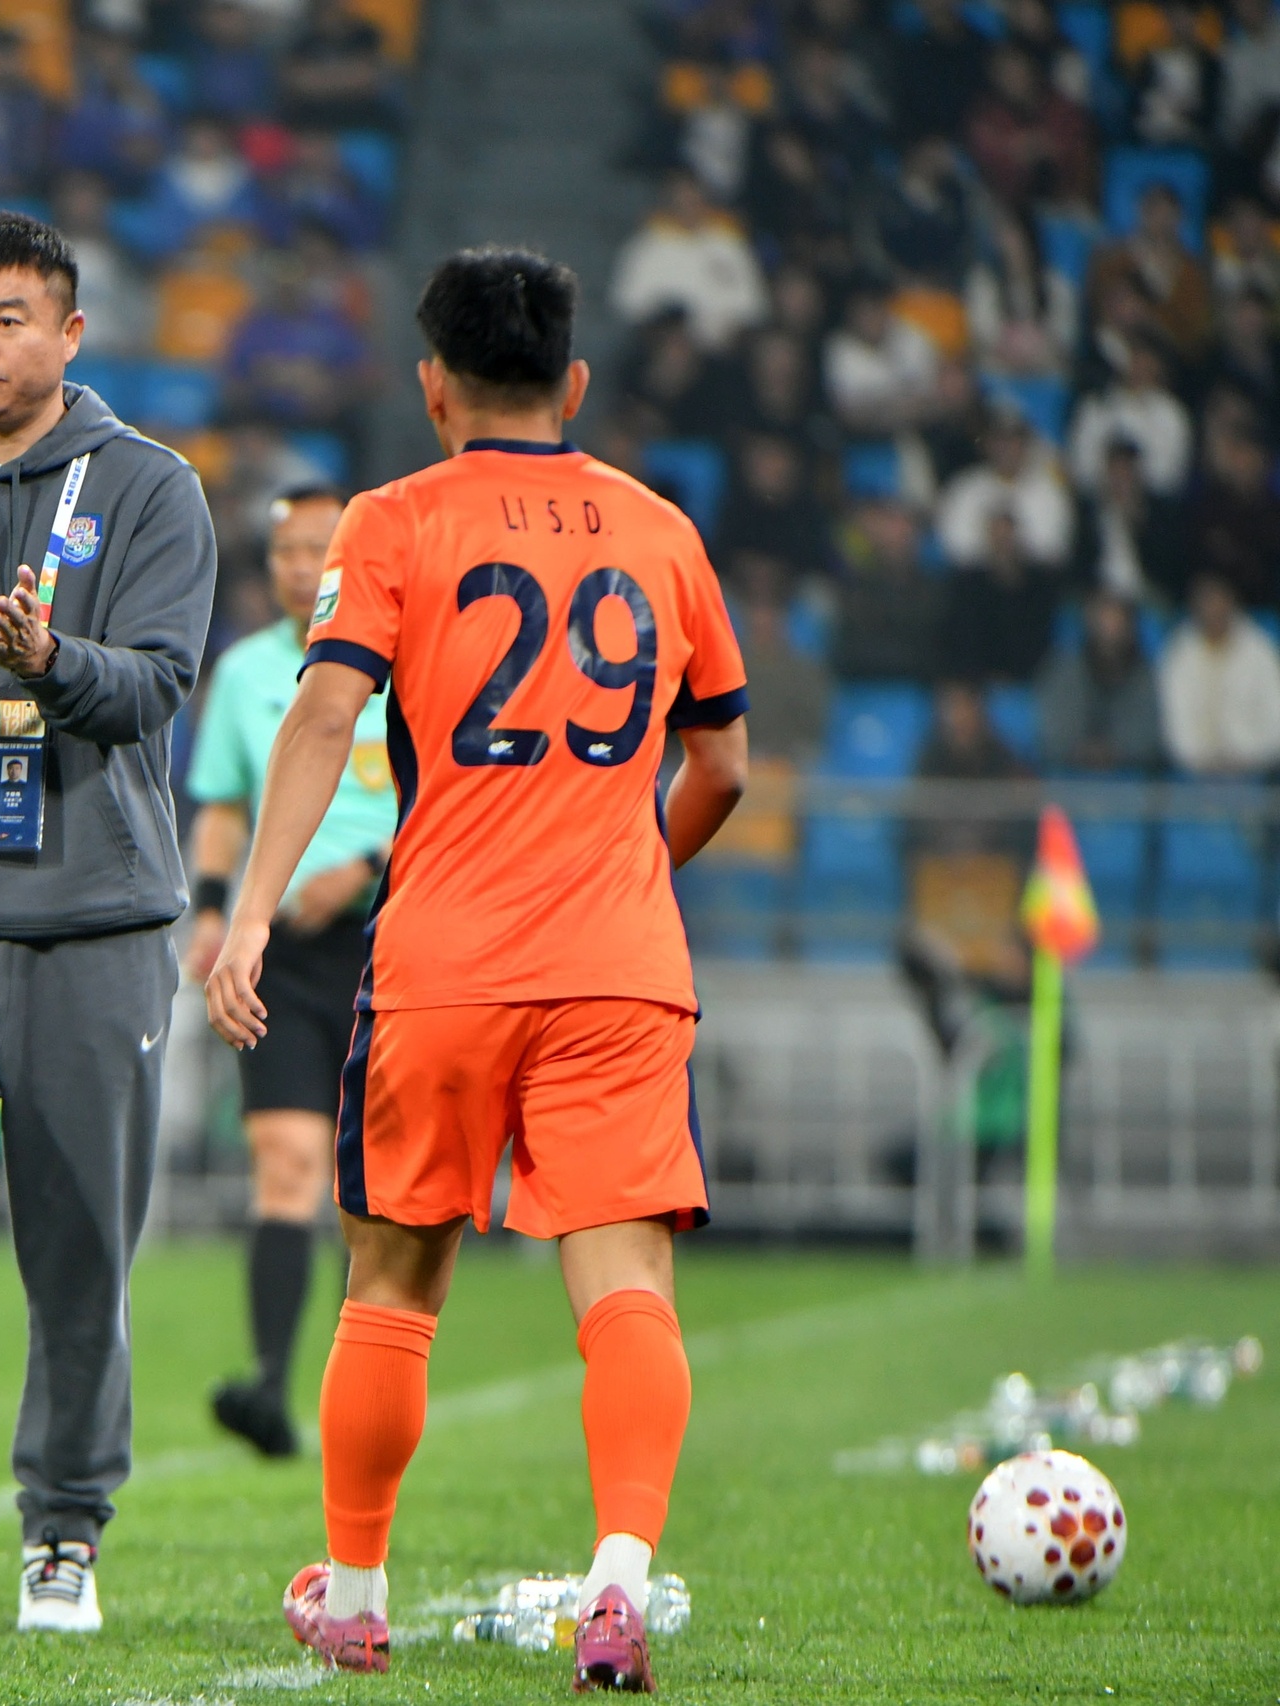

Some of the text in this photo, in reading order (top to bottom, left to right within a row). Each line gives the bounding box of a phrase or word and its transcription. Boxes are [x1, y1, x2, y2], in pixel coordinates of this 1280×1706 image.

[500, 495, 613, 535] LI S.D.
[451, 562, 658, 767] 29
